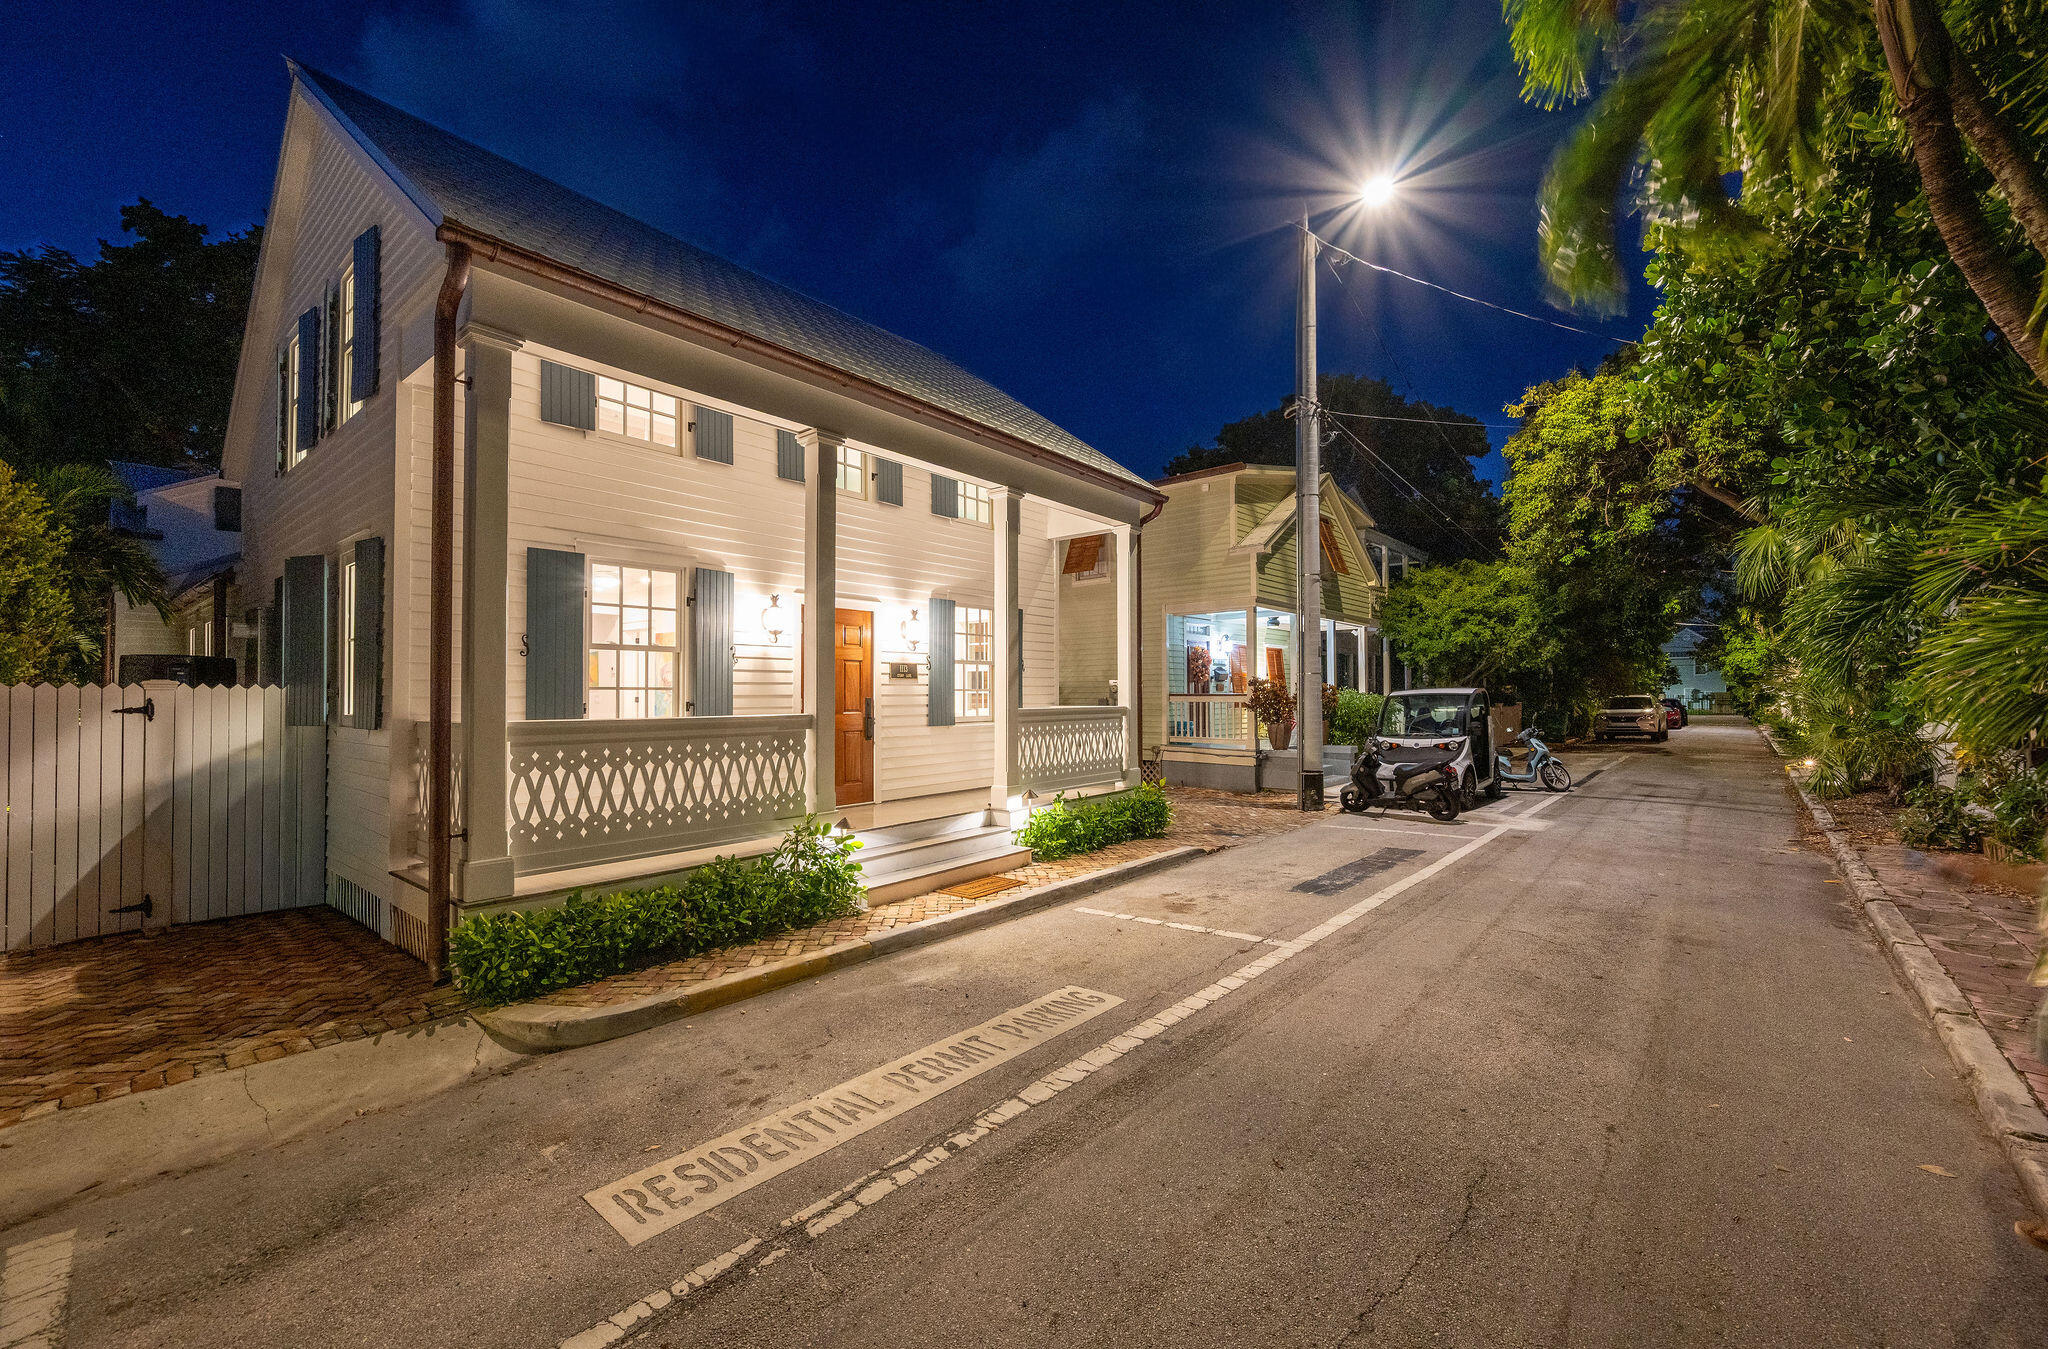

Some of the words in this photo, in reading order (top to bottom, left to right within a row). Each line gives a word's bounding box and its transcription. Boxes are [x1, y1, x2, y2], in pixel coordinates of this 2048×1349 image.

[612, 1090, 895, 1225] RESIDENTIAL
[881, 1034, 1006, 1093] PERMIT
[992, 990, 1106, 1040] PARKING
